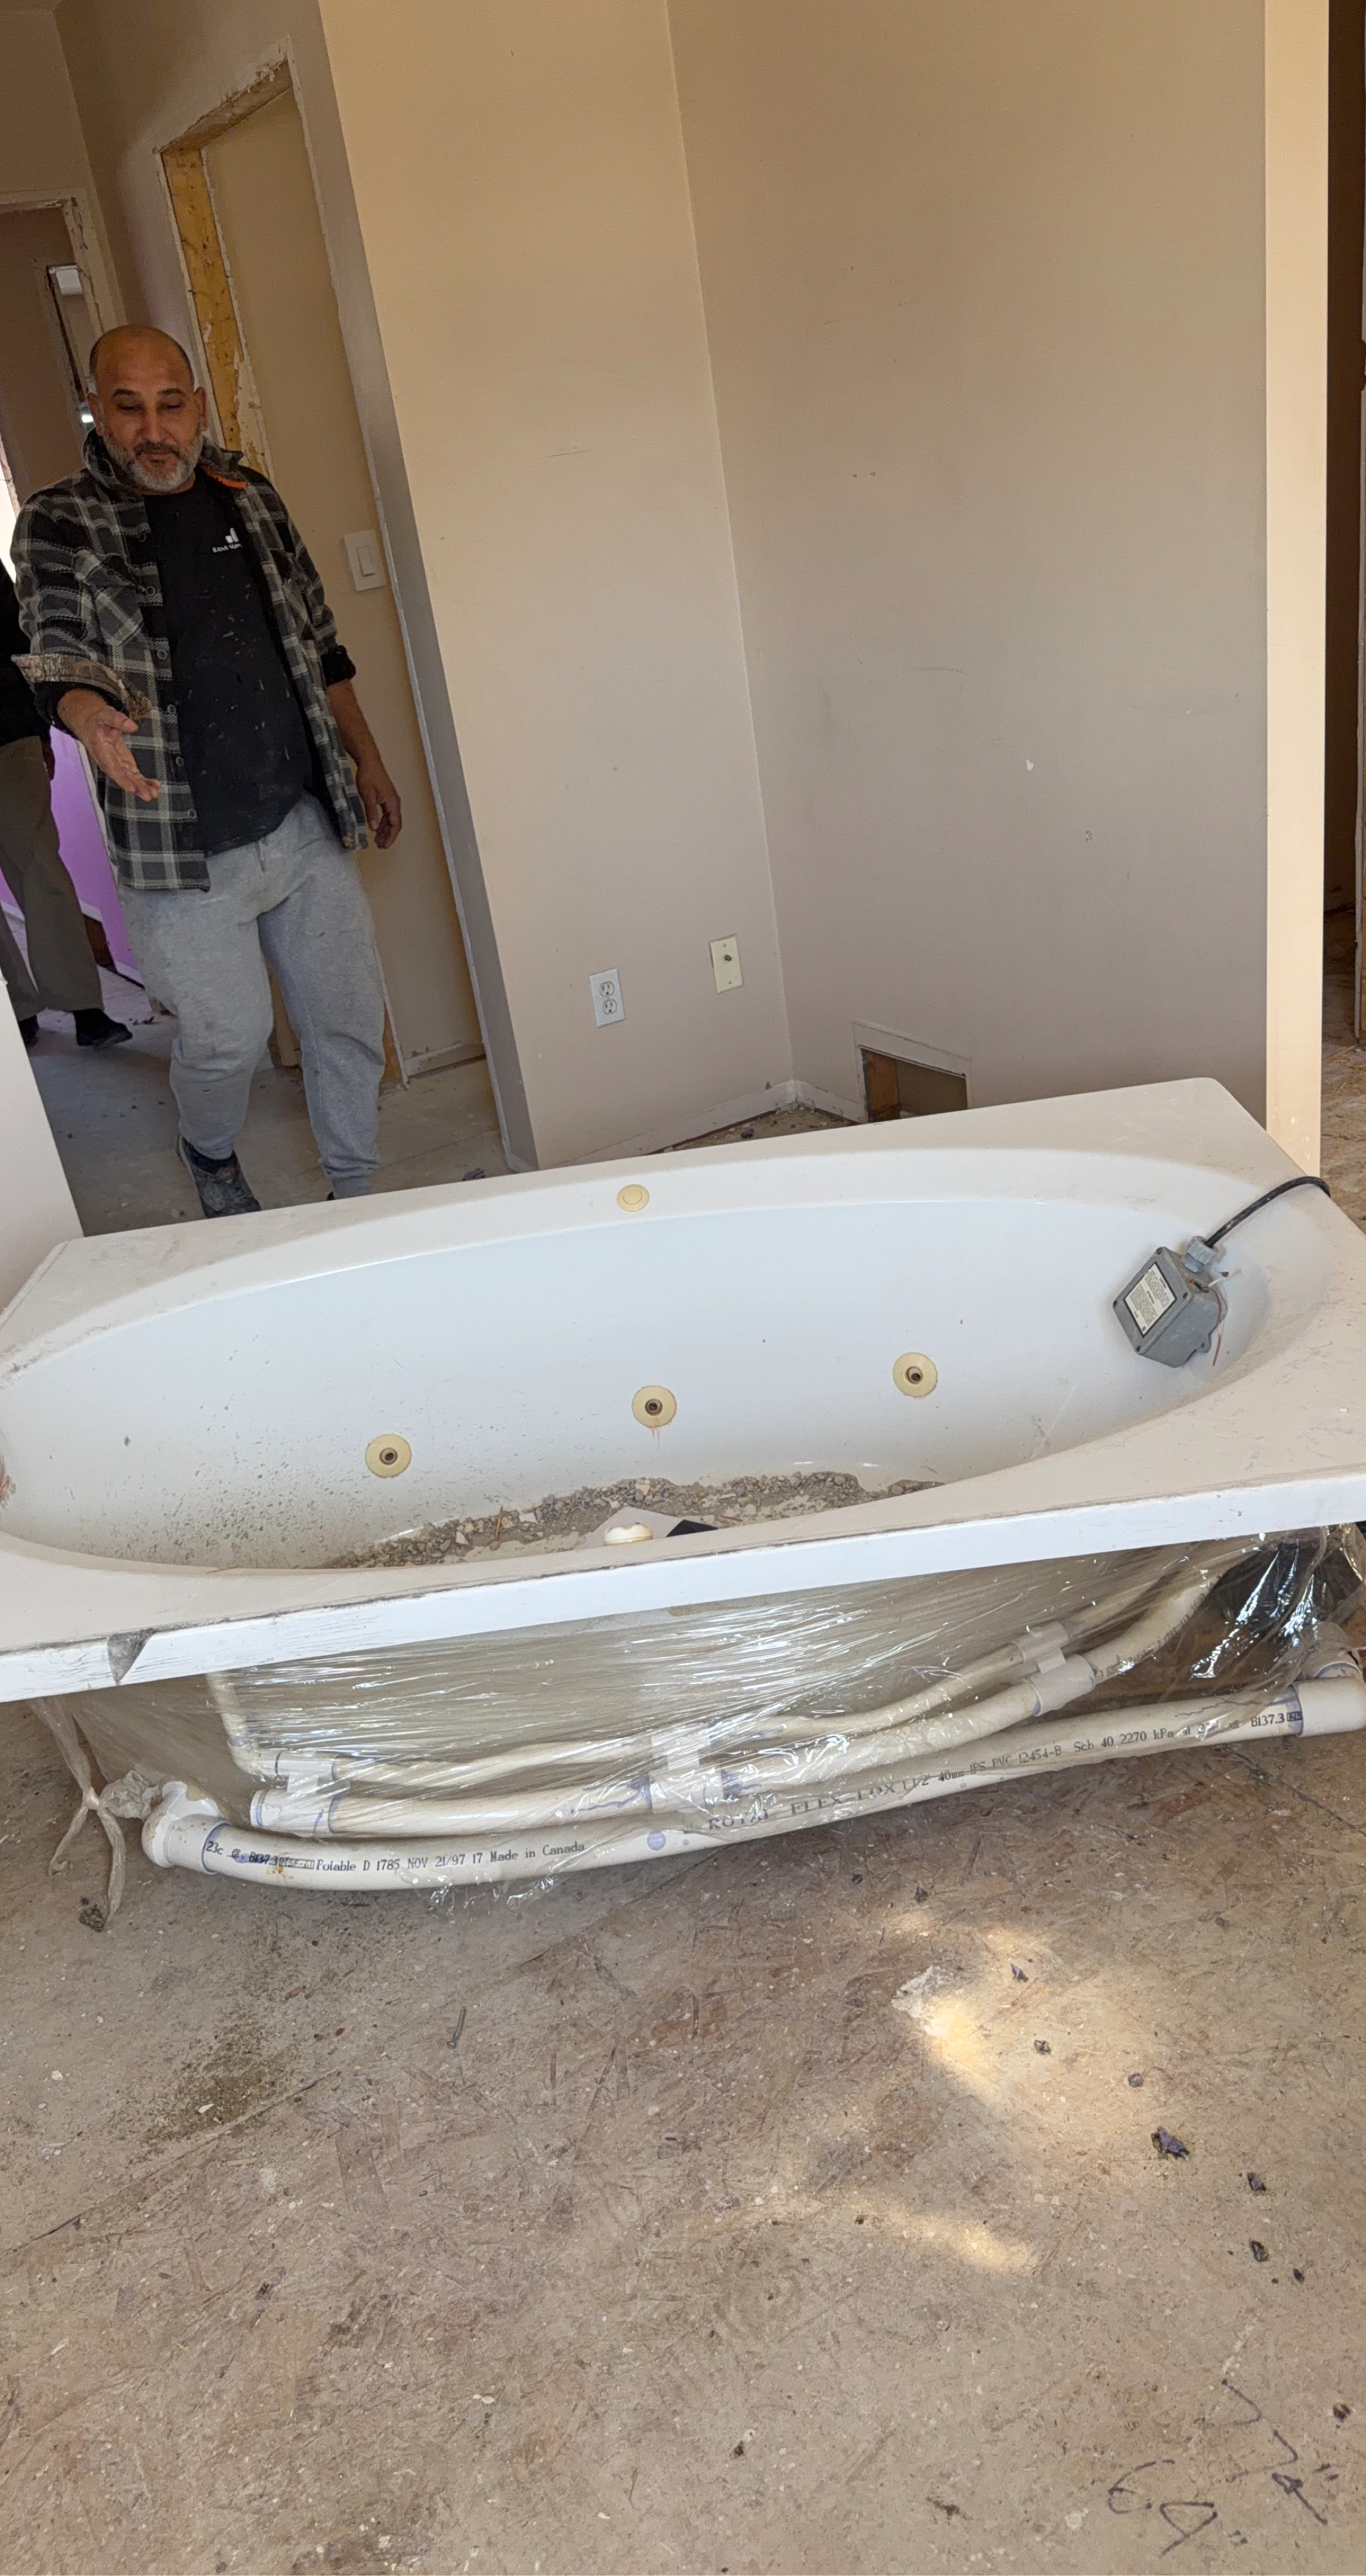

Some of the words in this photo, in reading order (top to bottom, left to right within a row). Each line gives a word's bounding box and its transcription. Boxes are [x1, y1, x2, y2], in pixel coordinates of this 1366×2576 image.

[1073, 1739, 1094, 1753] Sch
[1101, 1736, 1114, 1748] 40
[1119, 1731, 1147, 1745] 2270
[1153, 1727, 1175, 1740] kPa
[1251, 1713, 1286, 1727] B137.3
[316, 1860, 357, 1871] Potable
[363, 1860, 370, 1871] D
[376, 1859, 399, 1871] 1785
[407, 1857, 428, 1869] NOV
[435, 1853, 465, 1867] 21/97
[473, 1852, 483, 1864] 17
[490, 1849, 519, 1862] Made
[525, 1846, 536, 1858] in
[543, 1843, 585, 1856] Canada
